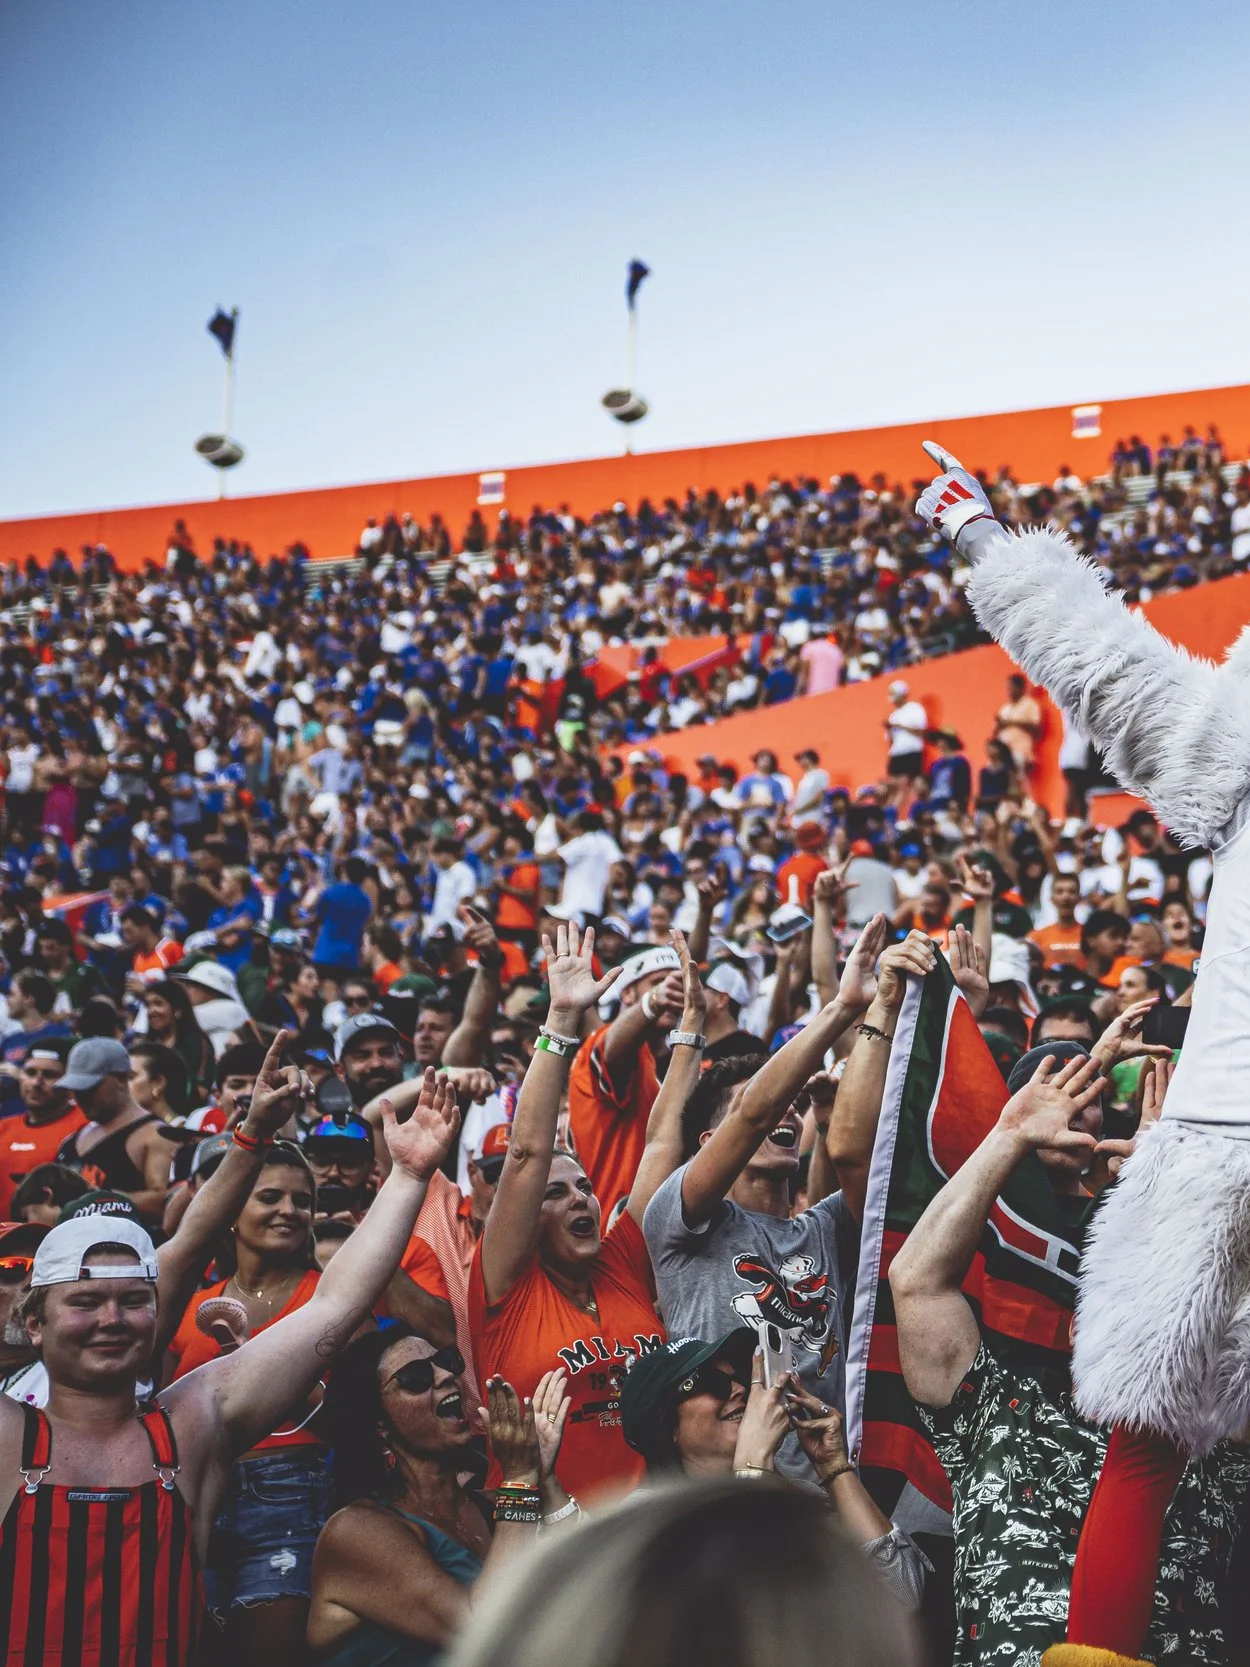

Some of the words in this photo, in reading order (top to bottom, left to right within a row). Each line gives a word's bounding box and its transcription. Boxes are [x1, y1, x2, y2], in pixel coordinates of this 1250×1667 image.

[73, 1201, 133, 1219] Miami
[557, 1334, 664, 1375] MIAM
[504, 1510, 537, 1521] CANES
